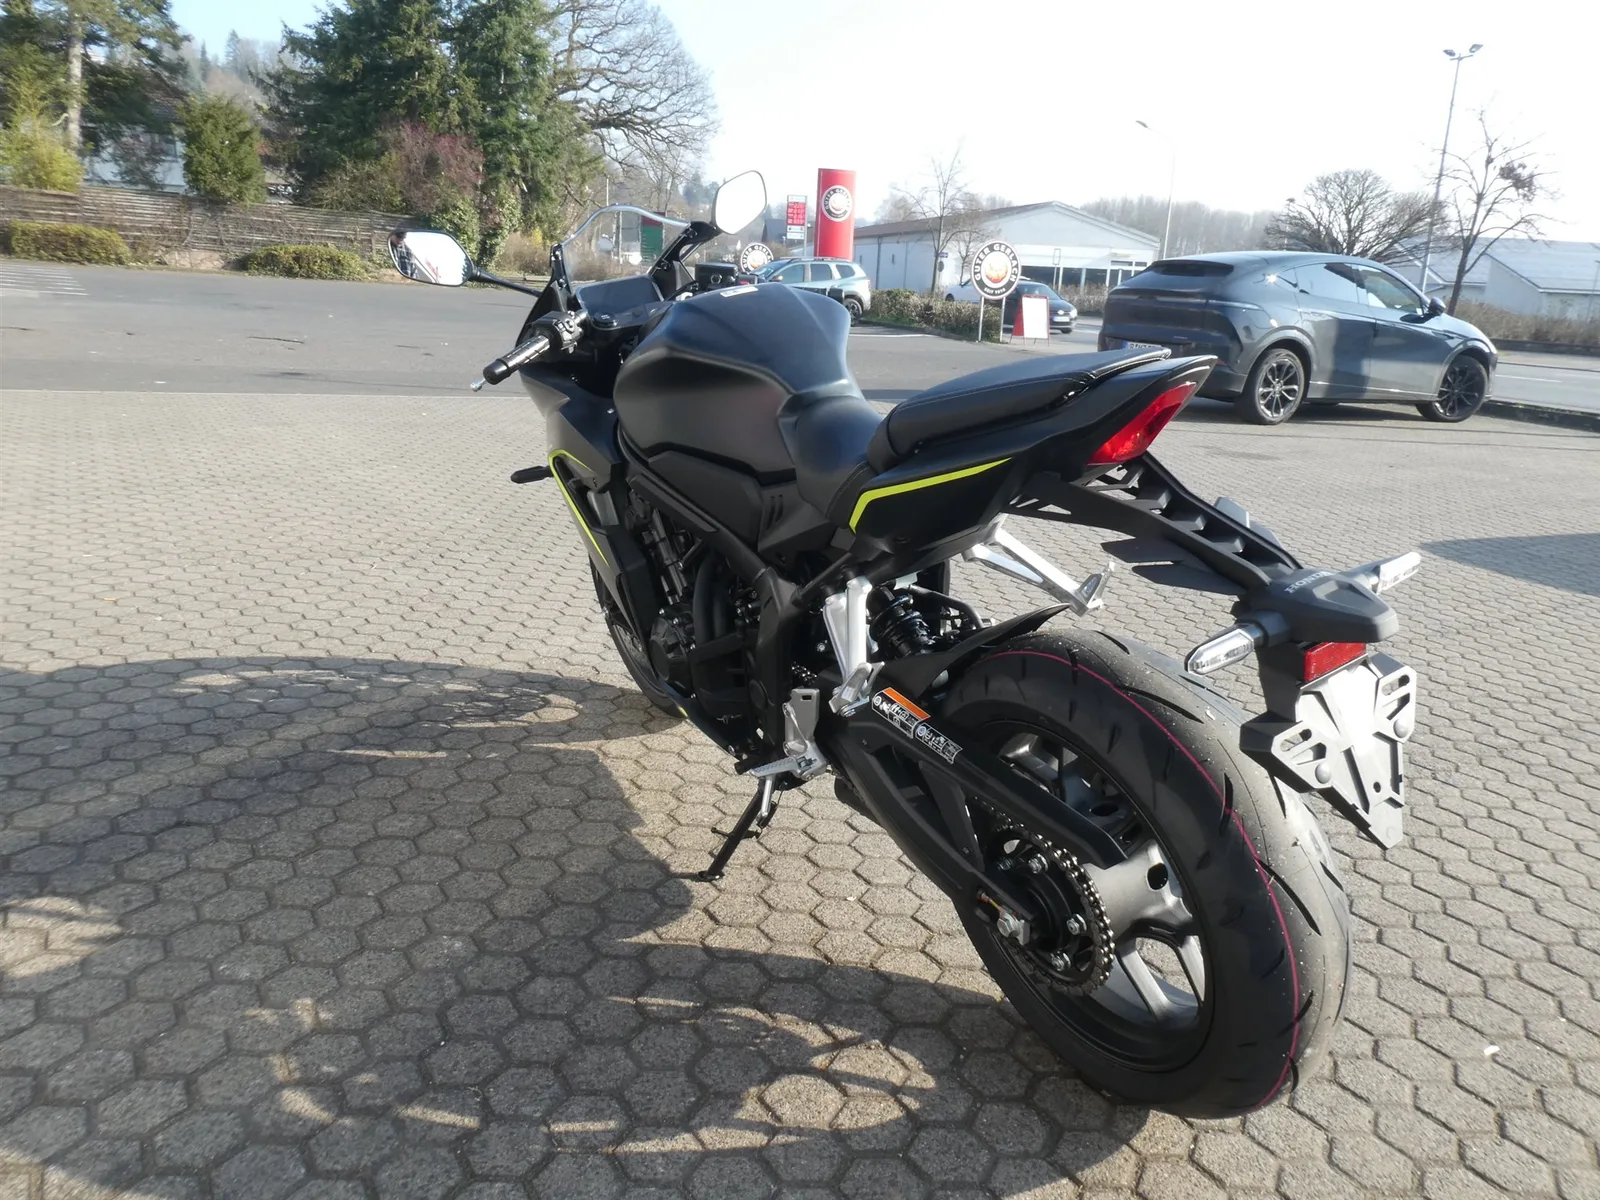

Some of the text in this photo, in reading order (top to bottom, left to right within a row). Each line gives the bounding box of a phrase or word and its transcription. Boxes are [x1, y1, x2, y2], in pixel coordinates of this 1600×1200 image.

[754, 245, 772, 264] GERLA
[974, 243, 1018, 282] GUTER GERLACH
[1284, 571, 1335, 593] HONDA
